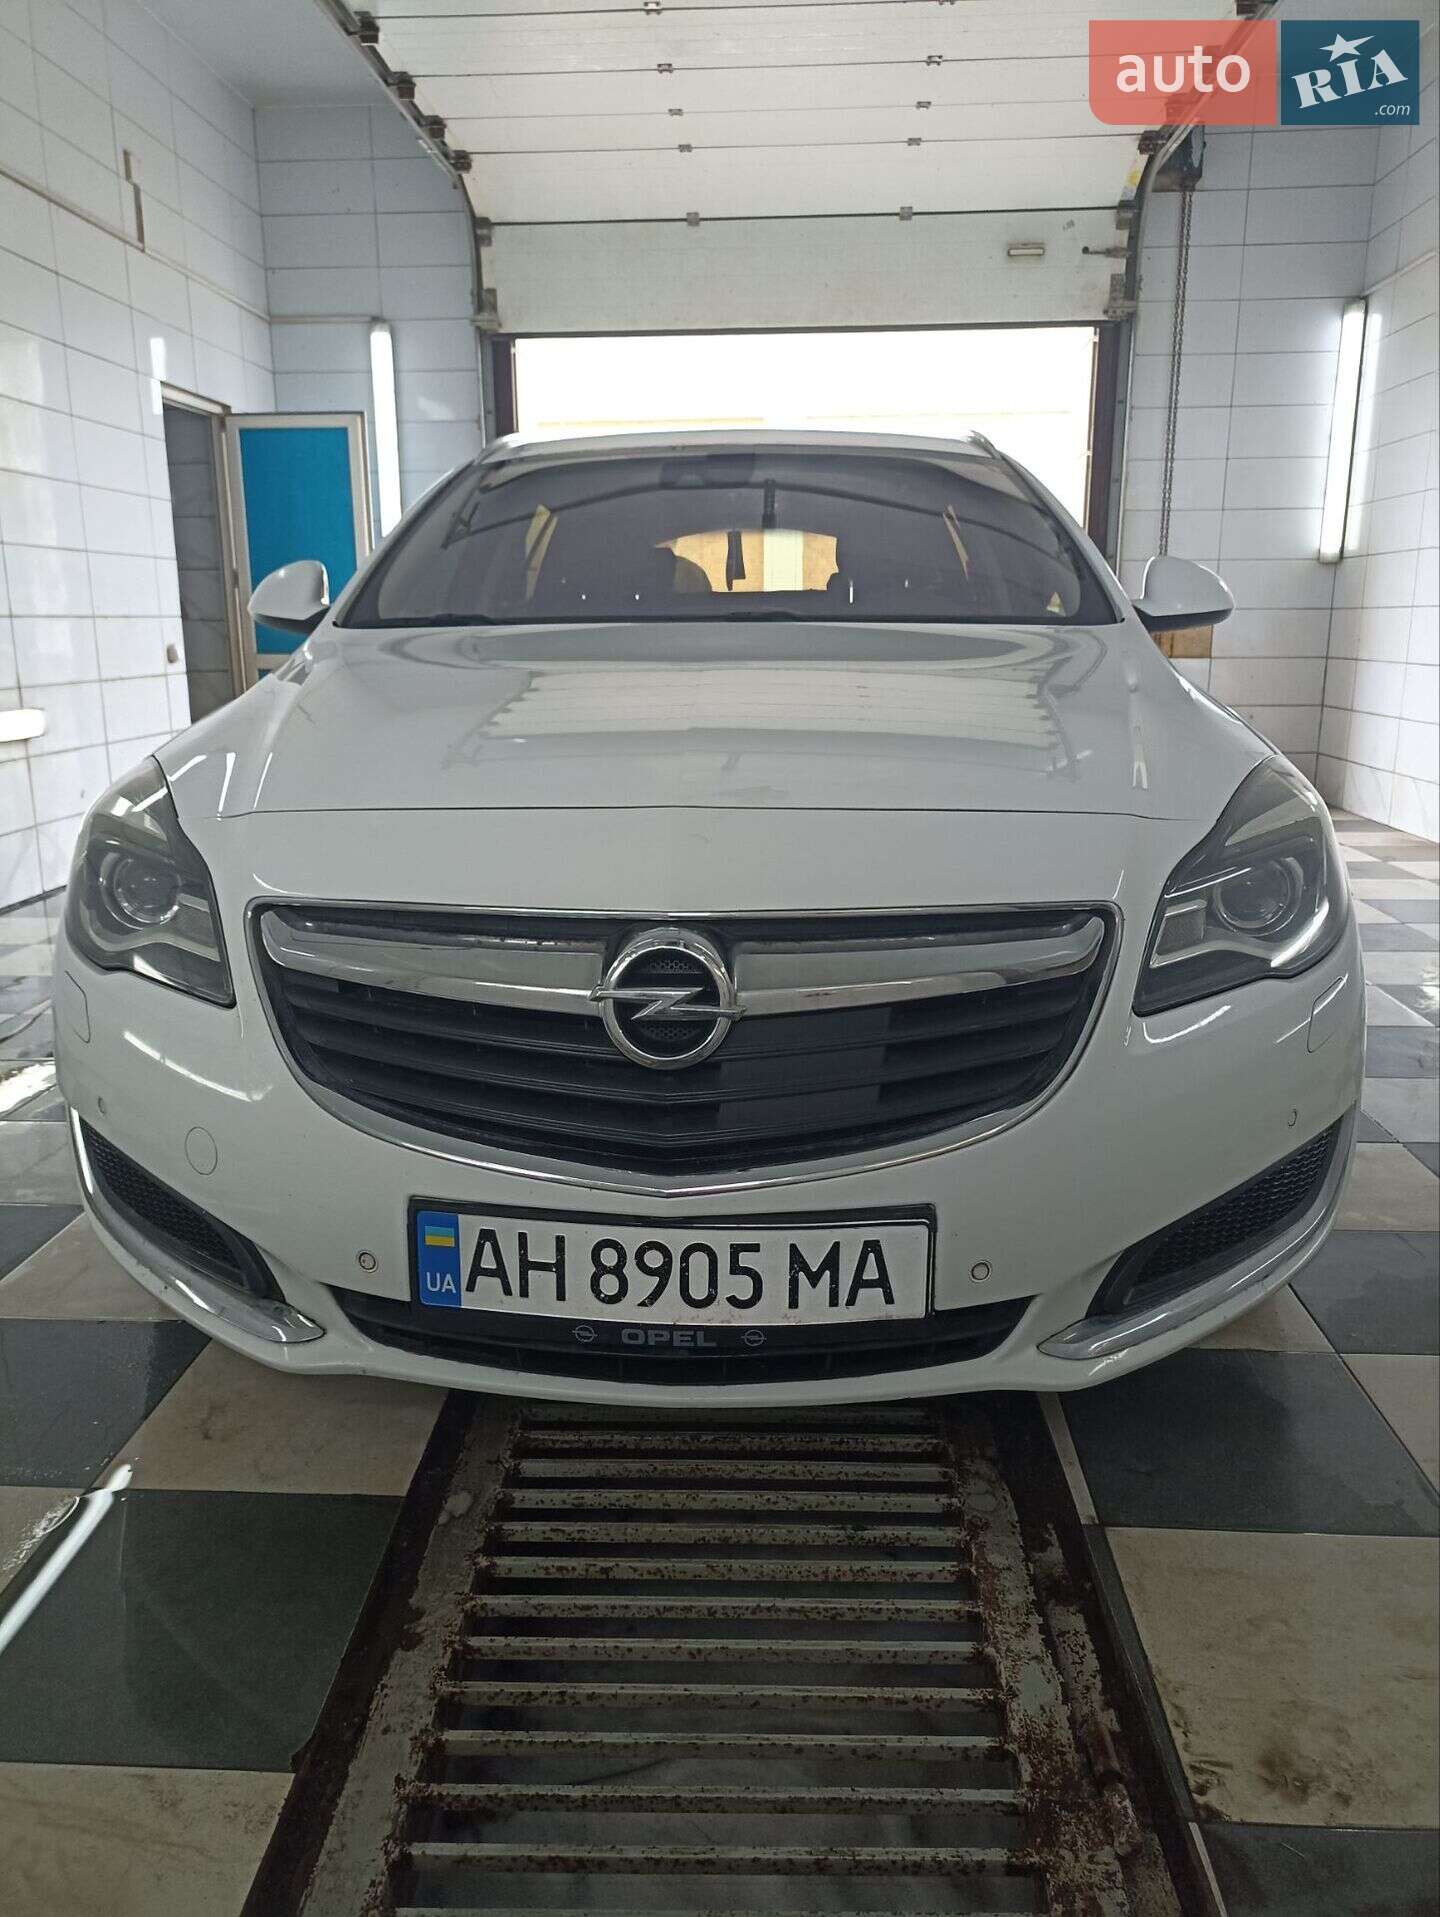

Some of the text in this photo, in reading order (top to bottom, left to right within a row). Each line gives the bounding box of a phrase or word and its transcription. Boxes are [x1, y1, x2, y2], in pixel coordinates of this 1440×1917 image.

[465, 1228, 895, 1309] AH 8905 MA
[426, 1271, 457, 1294] UA
[621, 1328, 717, 1347] OPEL
